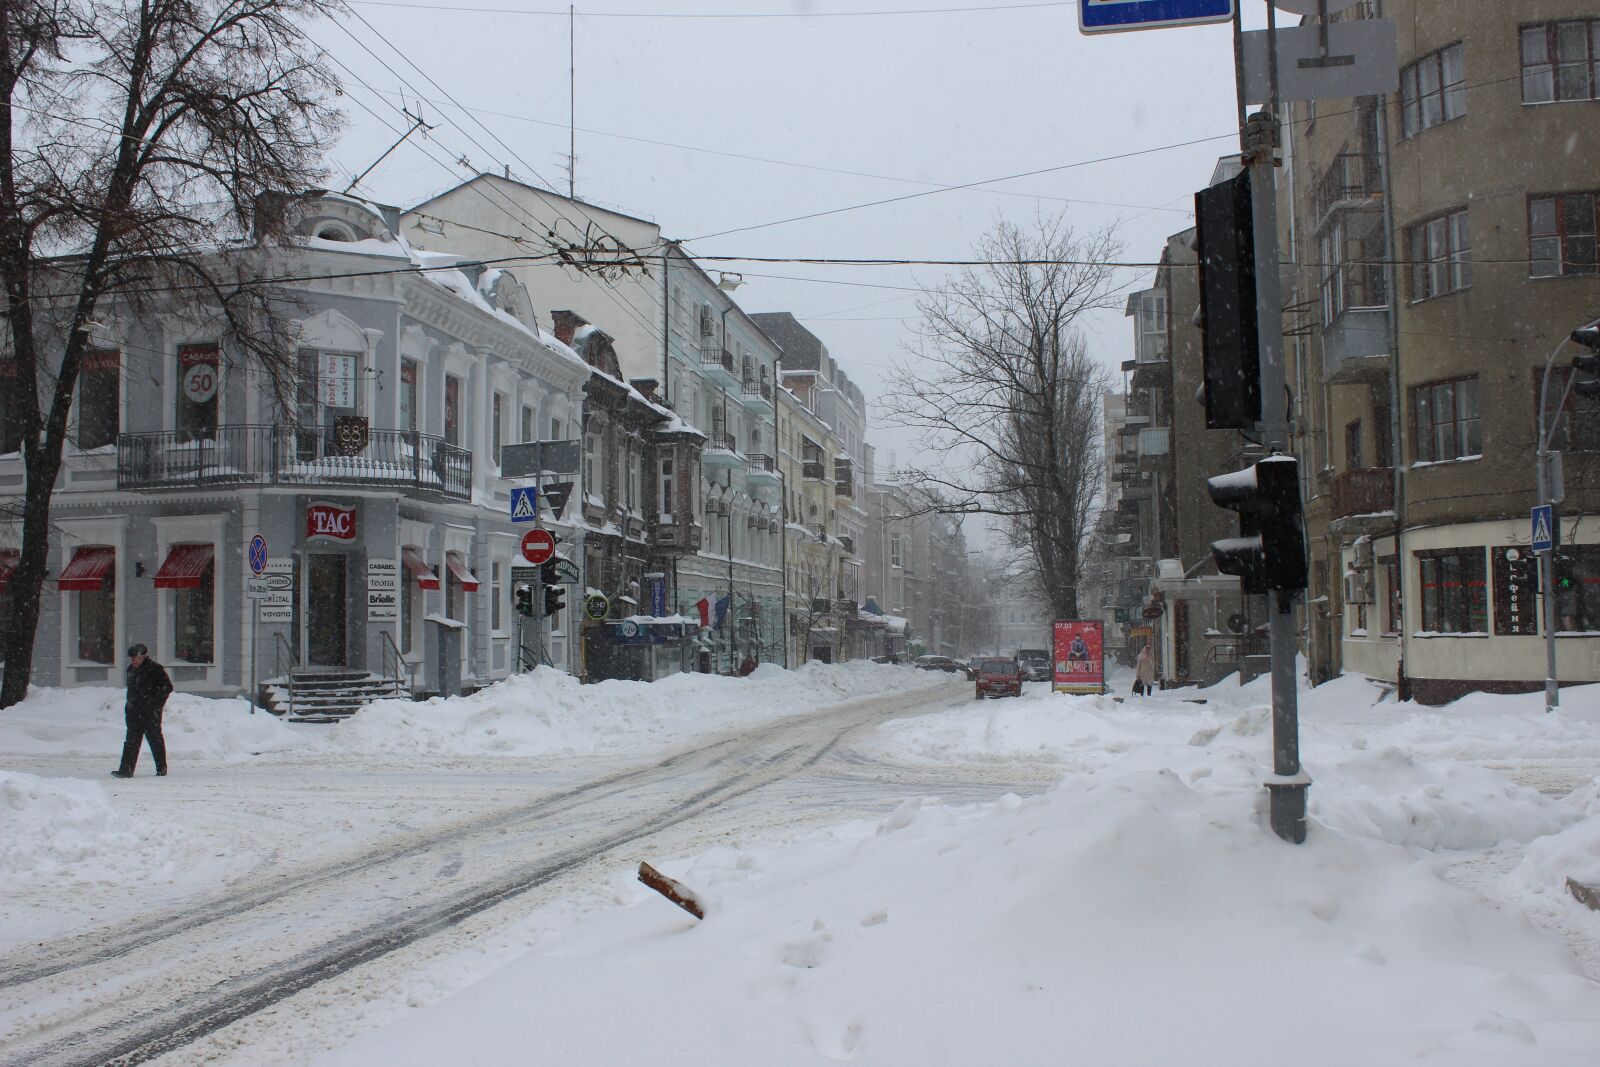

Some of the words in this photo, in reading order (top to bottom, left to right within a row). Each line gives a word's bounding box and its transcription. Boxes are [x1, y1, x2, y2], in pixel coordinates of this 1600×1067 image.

[190, 374, 212, 392] 50
[336, 425, 367, 442] 1881
[313, 511, 350, 533] TAC
[369, 594, 396, 604] Brielle
